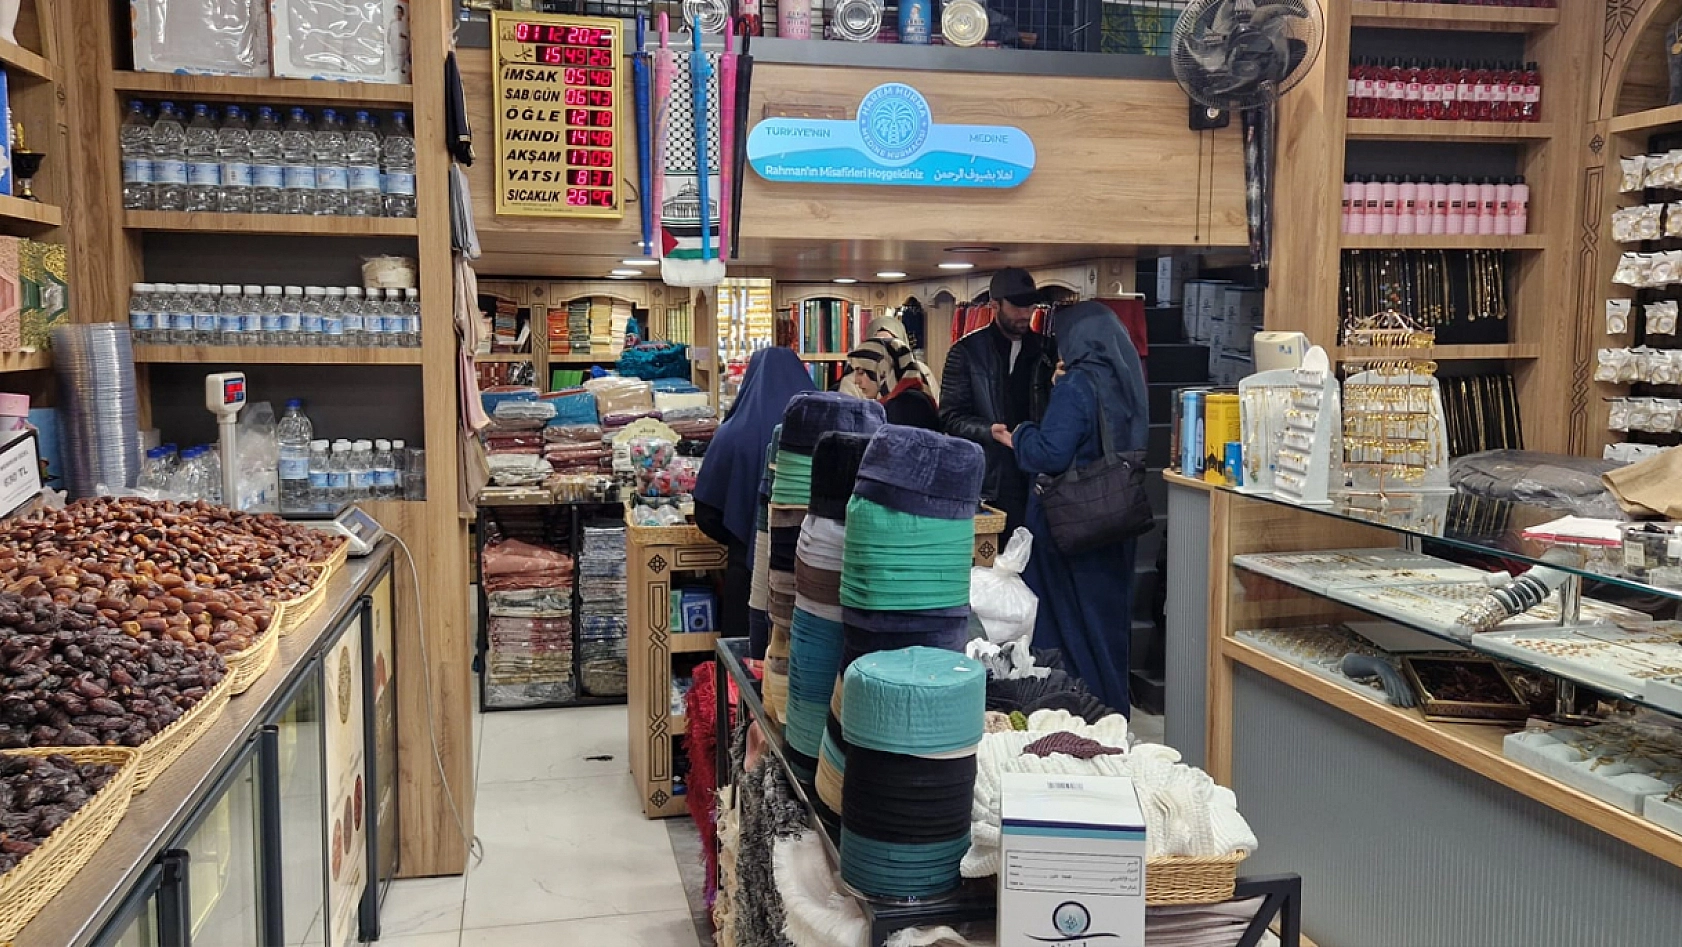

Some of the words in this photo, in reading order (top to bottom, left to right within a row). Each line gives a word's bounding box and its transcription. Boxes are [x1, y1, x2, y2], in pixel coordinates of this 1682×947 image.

[517, 23, 540, 41] 01
[548, 27, 563, 42] 12
[545, 46, 561, 63] 15
[565, 48, 586, 65] 49
[589, 50, 610, 66] 26
[565, 68, 587, 84] 05
[590, 70, 611, 86] 48
[565, 88, 587, 106] 06
[590, 91, 611, 107] 43
[506, 105, 561, 122] ÖĞLE
[571, 109, 587, 125] 12
[596, 111, 611, 126] 18
[571, 130, 588, 144] 14
[591, 130, 611, 146] 48
[506, 149, 561, 164] AKŞAM
[571, 150, 588, 164] 17
[591, 151, 611, 167] 09
[508, 170, 560, 182] YATSI
[576, 170, 588, 185] 8
[591, 170, 611, 186] 31
[507, 189, 560, 202] SICAKLIK
[566, 188, 588, 205] 26
